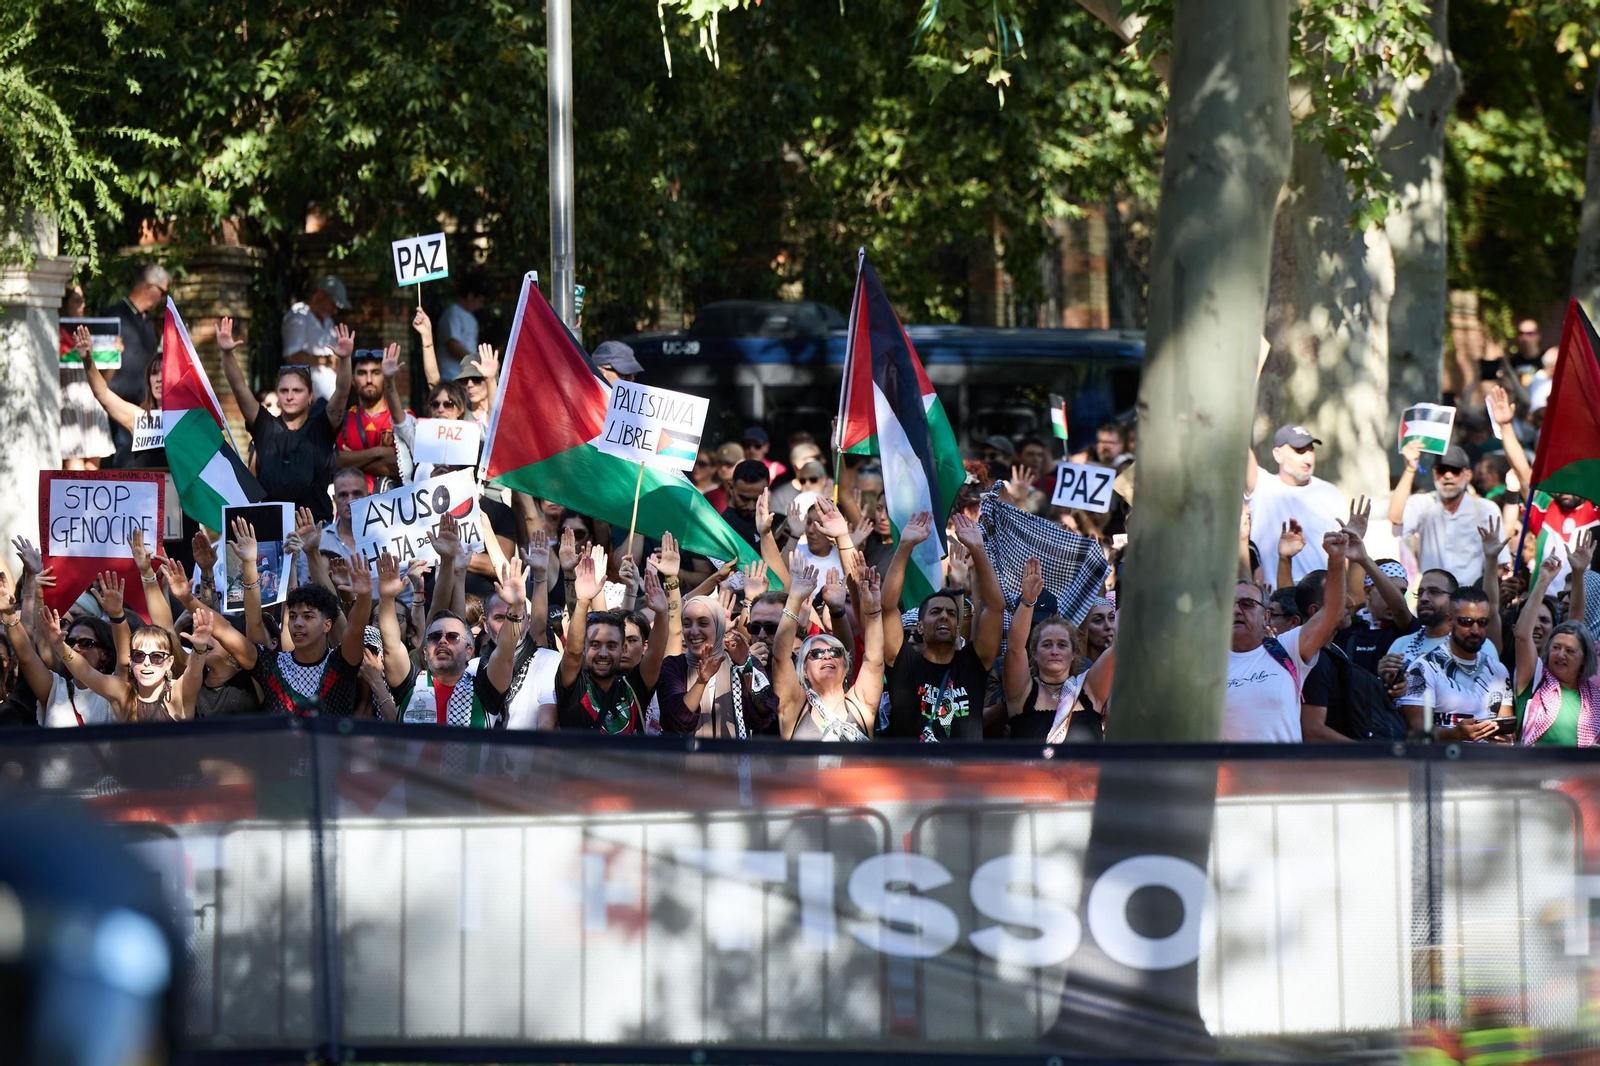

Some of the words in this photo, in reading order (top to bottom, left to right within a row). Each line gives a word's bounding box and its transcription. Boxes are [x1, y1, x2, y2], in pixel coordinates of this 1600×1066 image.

[397, 240, 443, 279] PAZ
[437, 425, 462, 440] PAZ
[64, 485, 131, 513] STOP
[1057, 467, 1110, 506] PAZ
[362, 485, 451, 537] AYUSO
[672, 848, 1335, 971] TISSO
